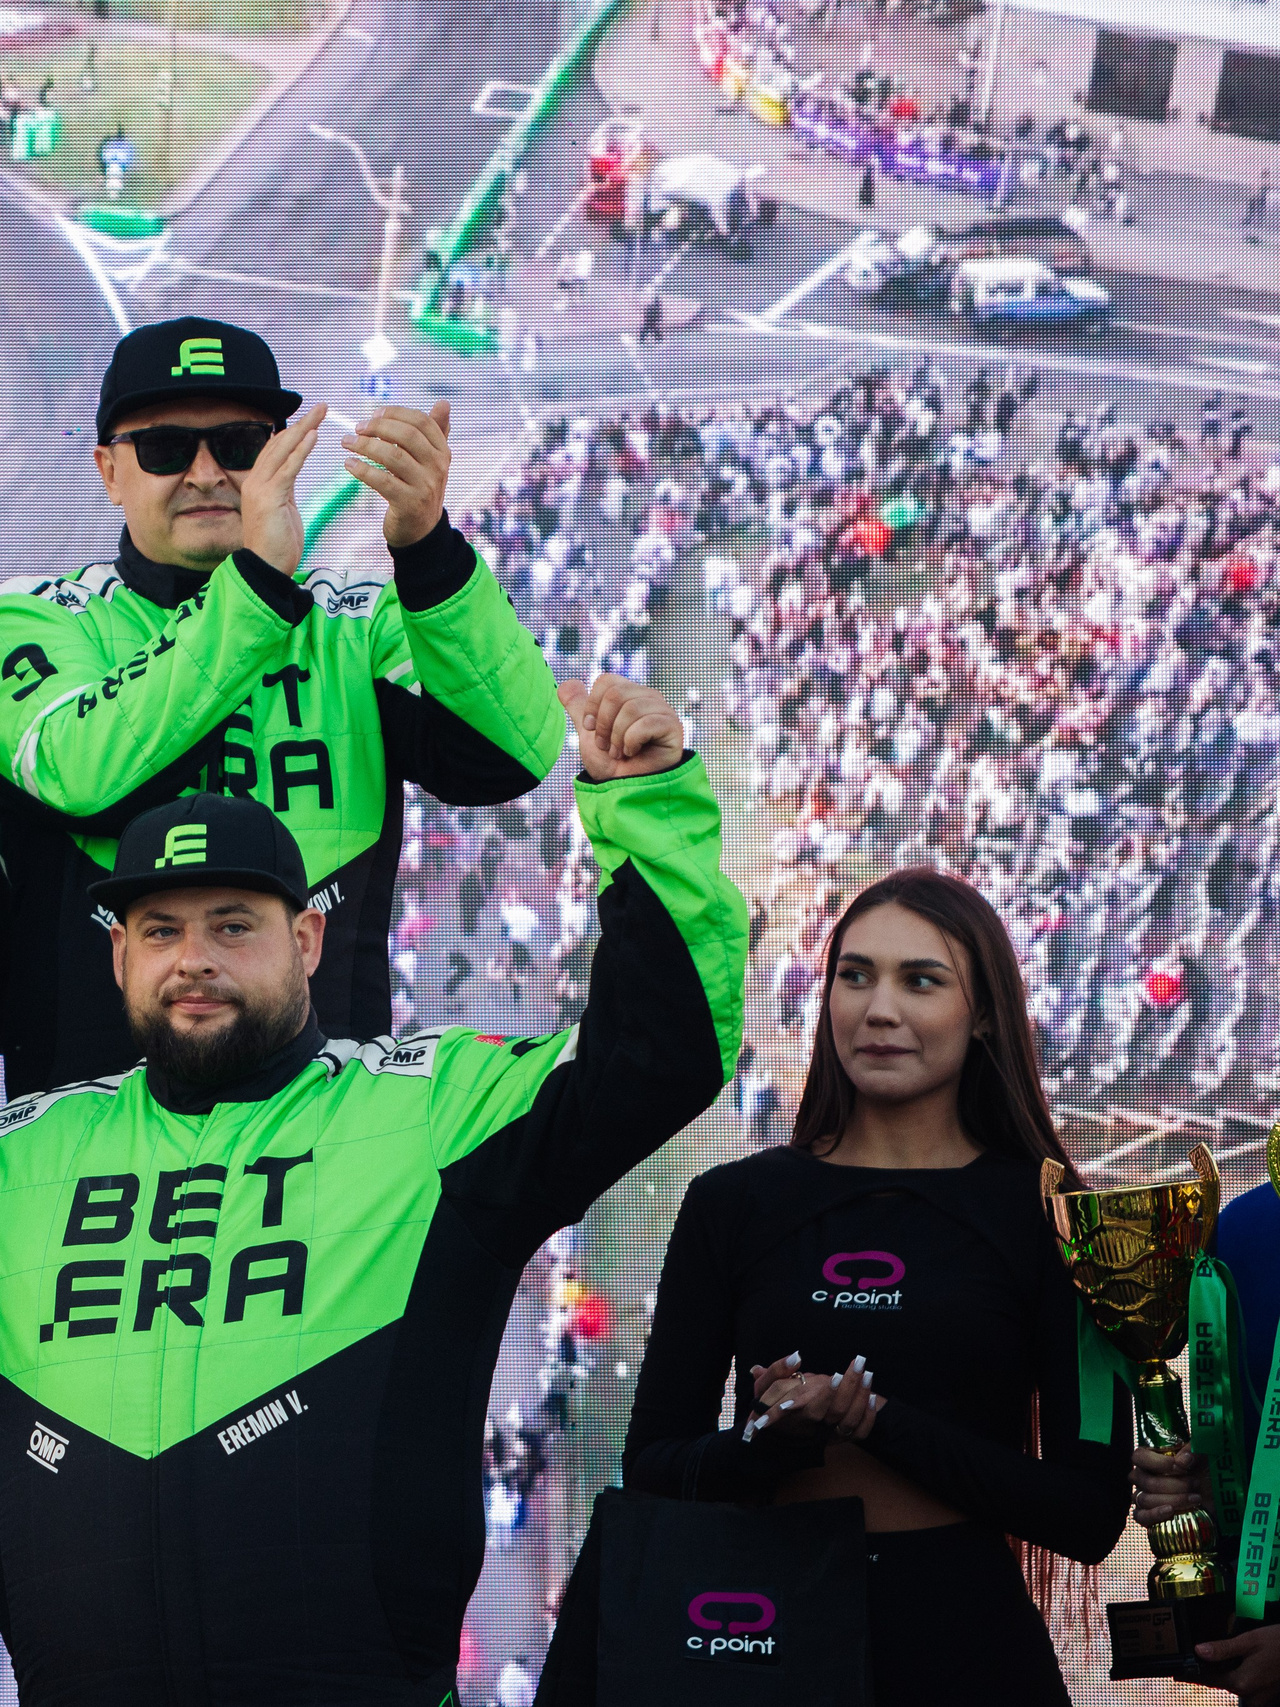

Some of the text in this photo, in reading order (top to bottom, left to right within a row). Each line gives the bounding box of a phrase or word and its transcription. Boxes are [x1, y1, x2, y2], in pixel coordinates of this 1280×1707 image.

[61, 1147, 314, 1248] BET
[28, 1427, 67, 1465] OMP
[217, 1390, 309, 1455] EREMIN V.
